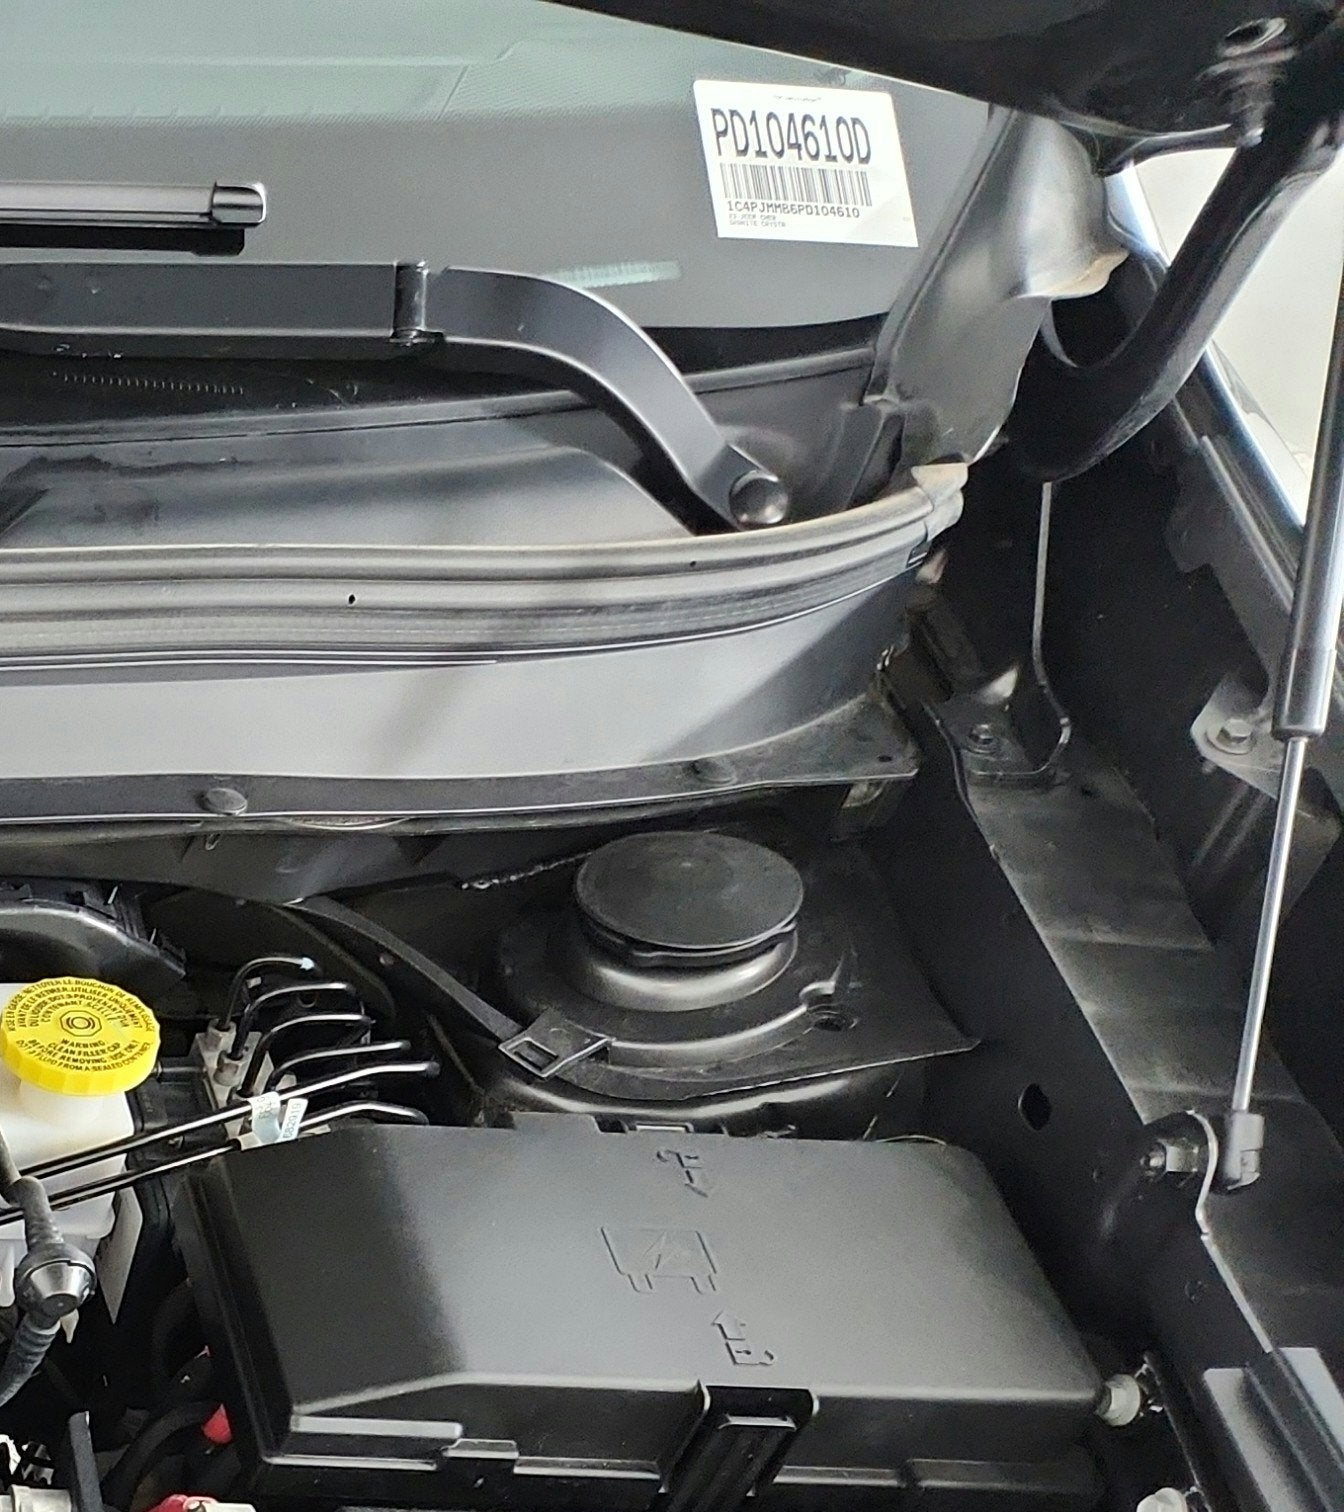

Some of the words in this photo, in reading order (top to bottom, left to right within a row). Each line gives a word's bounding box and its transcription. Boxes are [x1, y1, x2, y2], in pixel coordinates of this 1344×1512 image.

[710, 108, 871, 165] PD104610D
[28, 1039, 58, 1057] BEFORE
[48, 1042, 76, 1055] CLEAN
[77, 1048, 107, 1057] FILLER
[61, 1038, 105, 1048] WARNING
[57, 1061, 83, 1071] FROM
